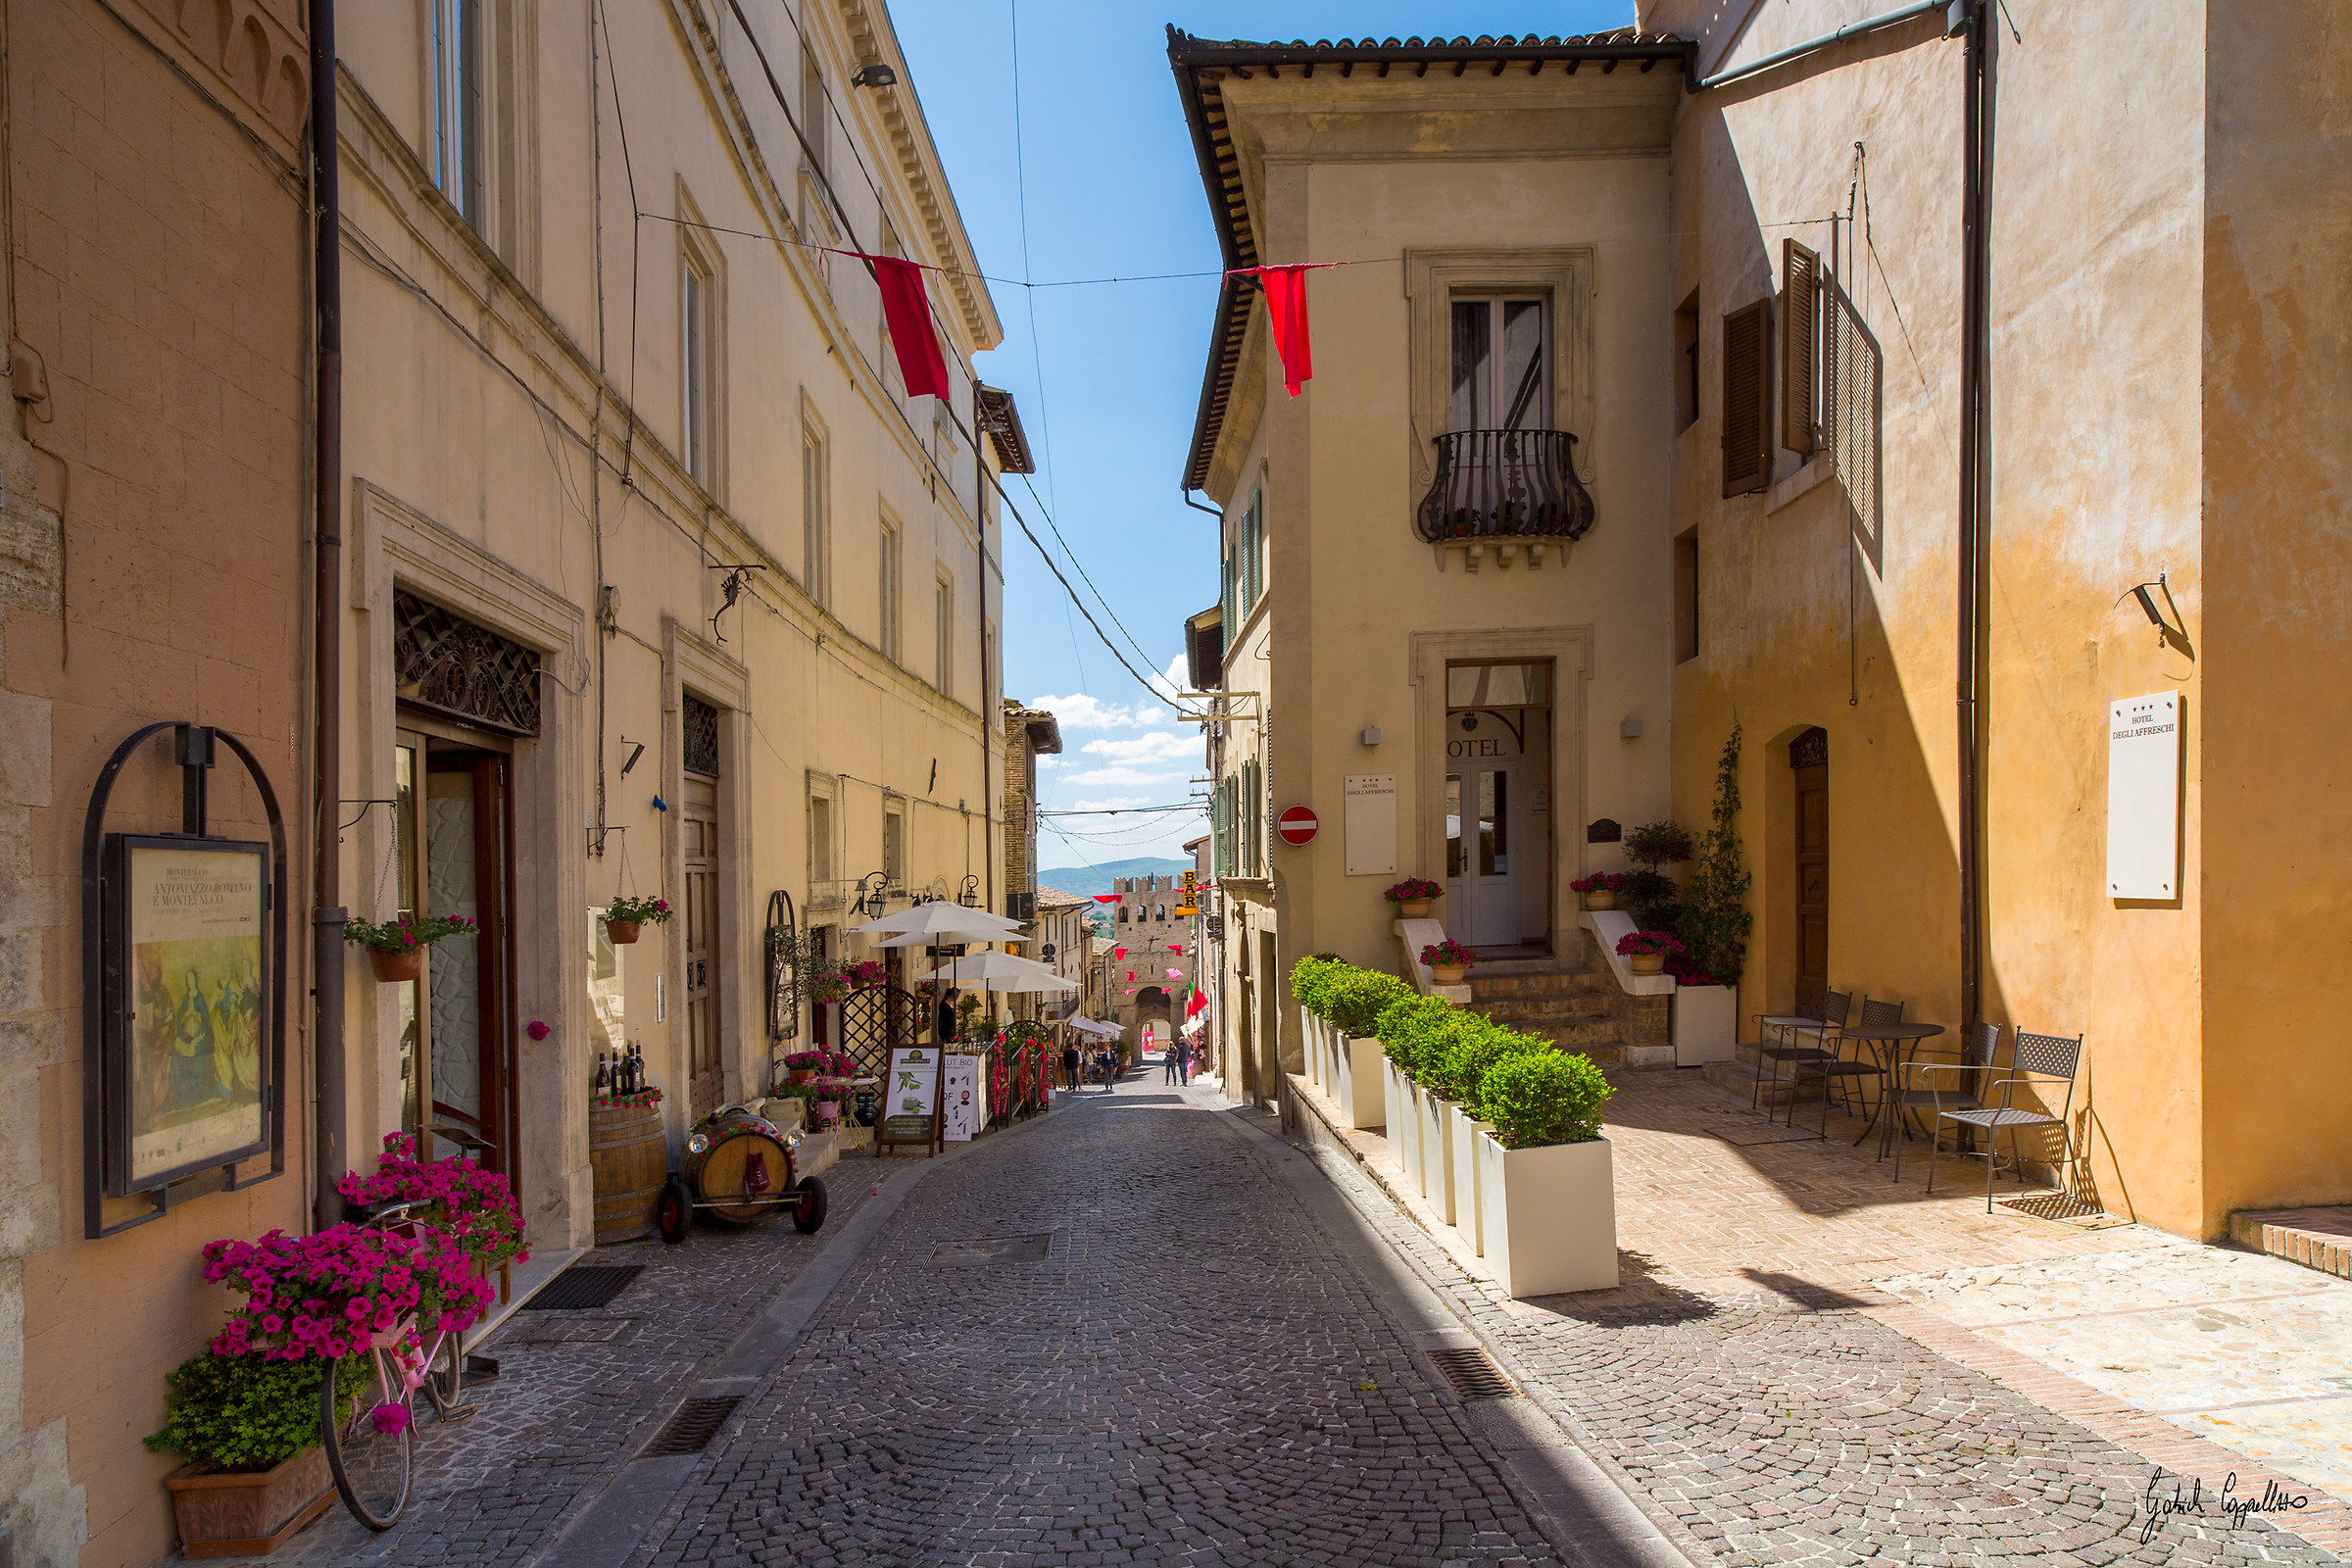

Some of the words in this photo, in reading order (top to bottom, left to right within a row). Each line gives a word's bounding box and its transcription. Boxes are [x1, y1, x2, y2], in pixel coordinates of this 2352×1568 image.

[2132, 714, 2154, 725] HOTEL
[2112, 729, 2133, 740] DEGLI
[2134, 723, 2175, 737] AFFRESCHI
[1446, 739, 1507, 759] OTEL
[1184, 871, 1196, 906] BAR
